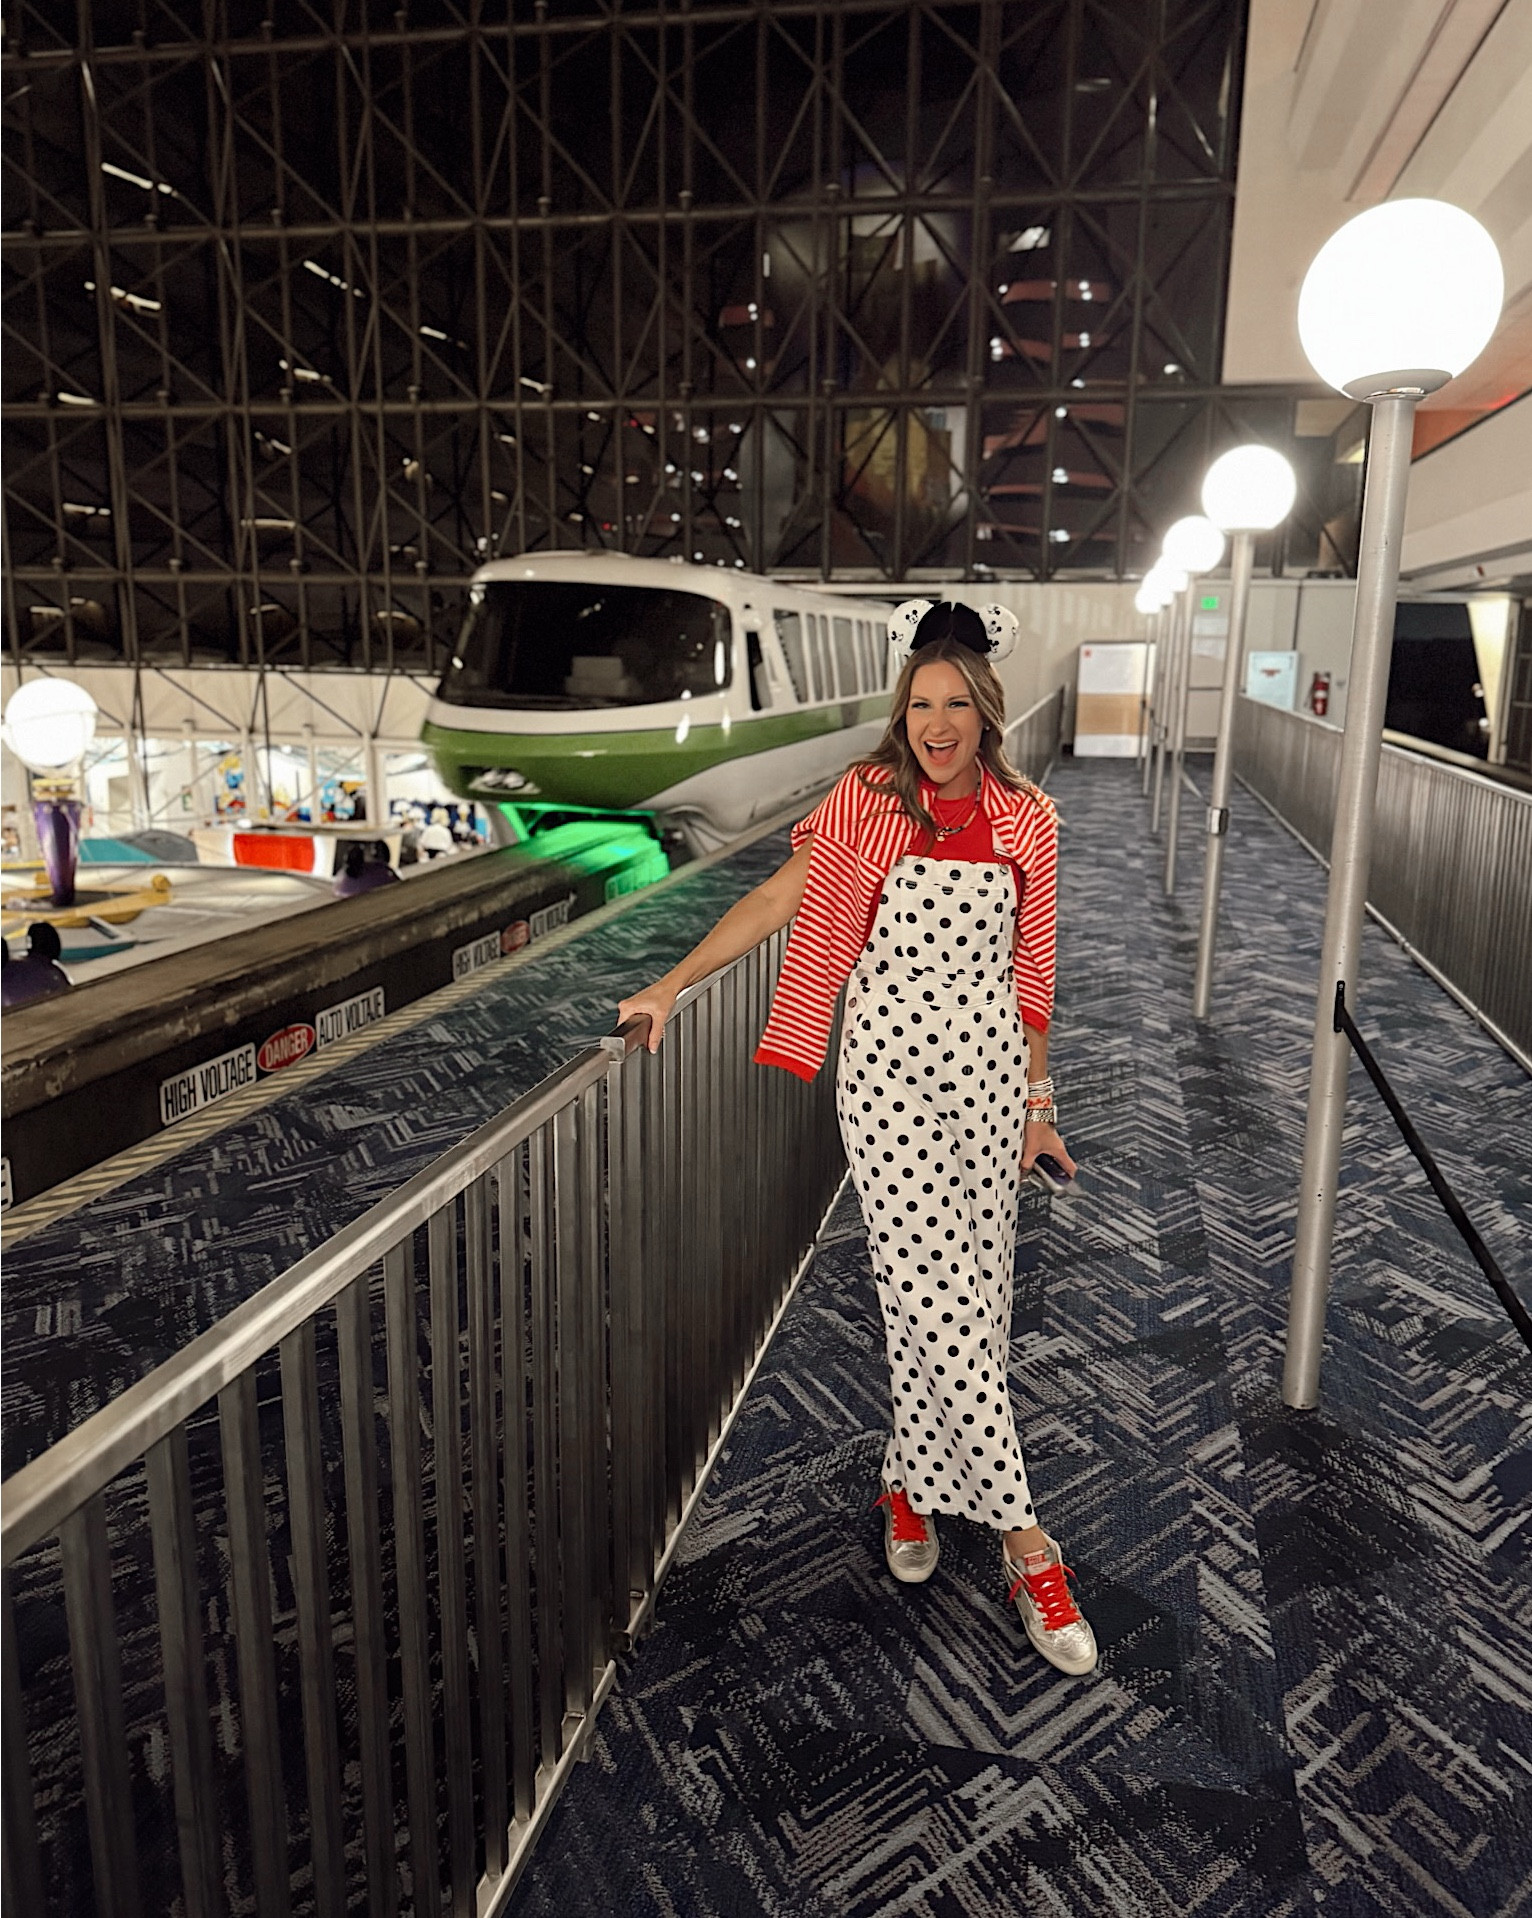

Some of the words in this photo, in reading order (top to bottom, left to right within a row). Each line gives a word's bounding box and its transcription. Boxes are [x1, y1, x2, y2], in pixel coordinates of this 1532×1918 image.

[265, 1028, 309, 1068] DANGER
[319, 1009, 343, 1047] ALTO
[164, 1074, 197, 1120] HIGH
[200, 1049, 253, 1102] VOLTAGE
